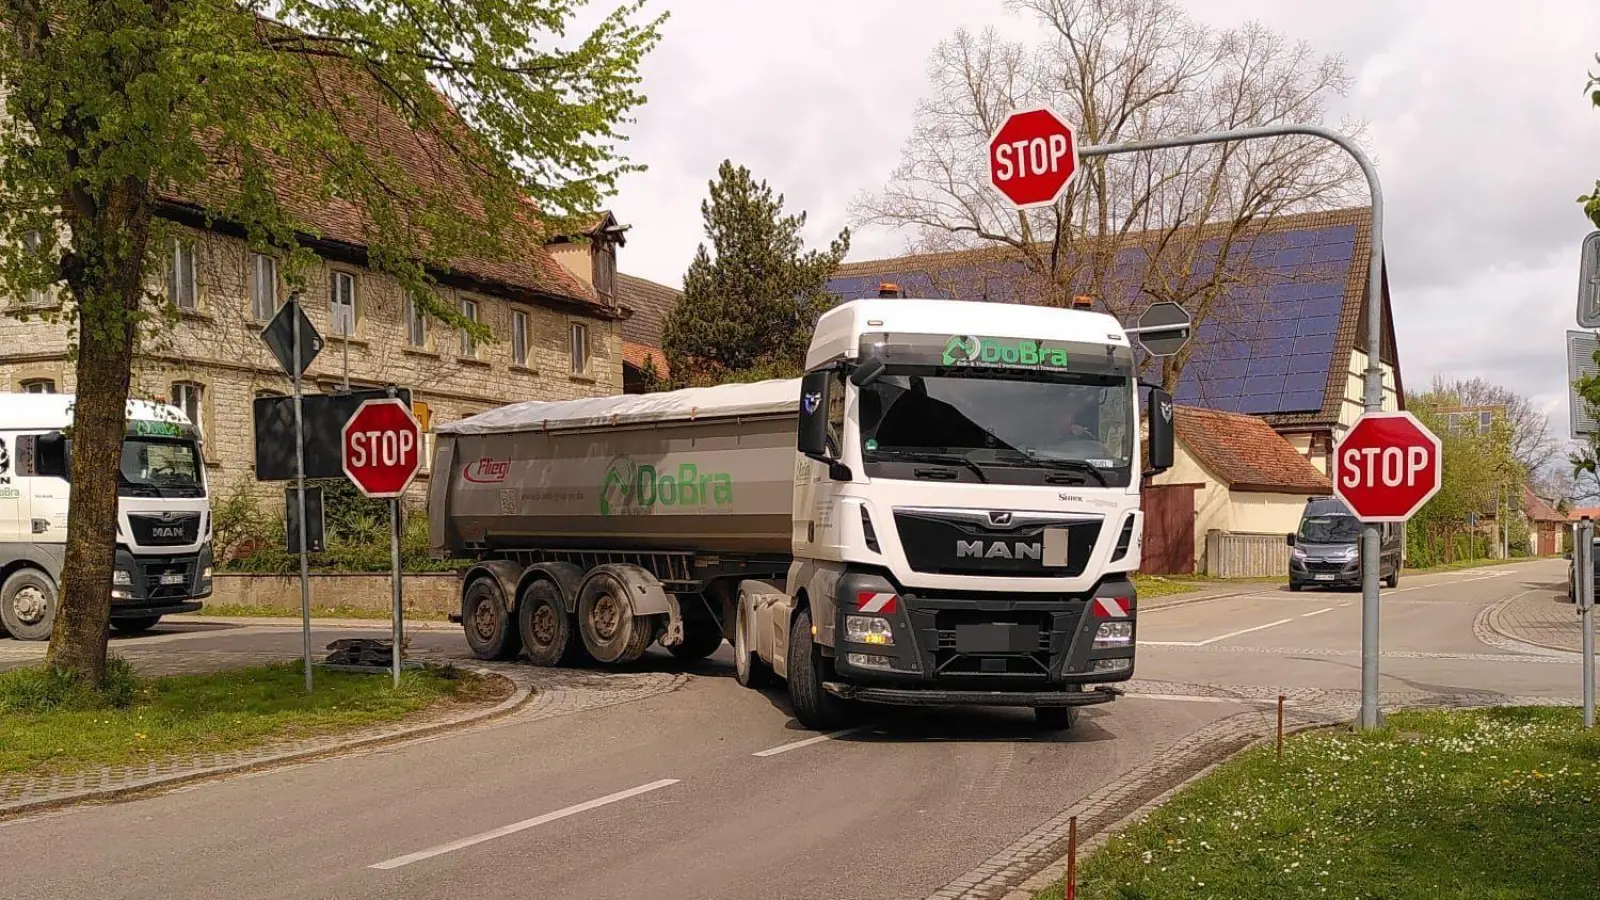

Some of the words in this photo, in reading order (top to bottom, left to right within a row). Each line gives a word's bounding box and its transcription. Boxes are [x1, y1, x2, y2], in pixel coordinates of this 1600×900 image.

[996, 134, 1067, 181] STOP
[981, 339, 1068, 367] DoBra
[351, 429, 414, 467] STOP
[477, 456, 512, 480] Fliegl
[1343, 446, 1428, 488] STOP
[637, 463, 733, 506] DoBra
[152, 527, 184, 537] MAN
[956, 540, 1041, 560] MAN
